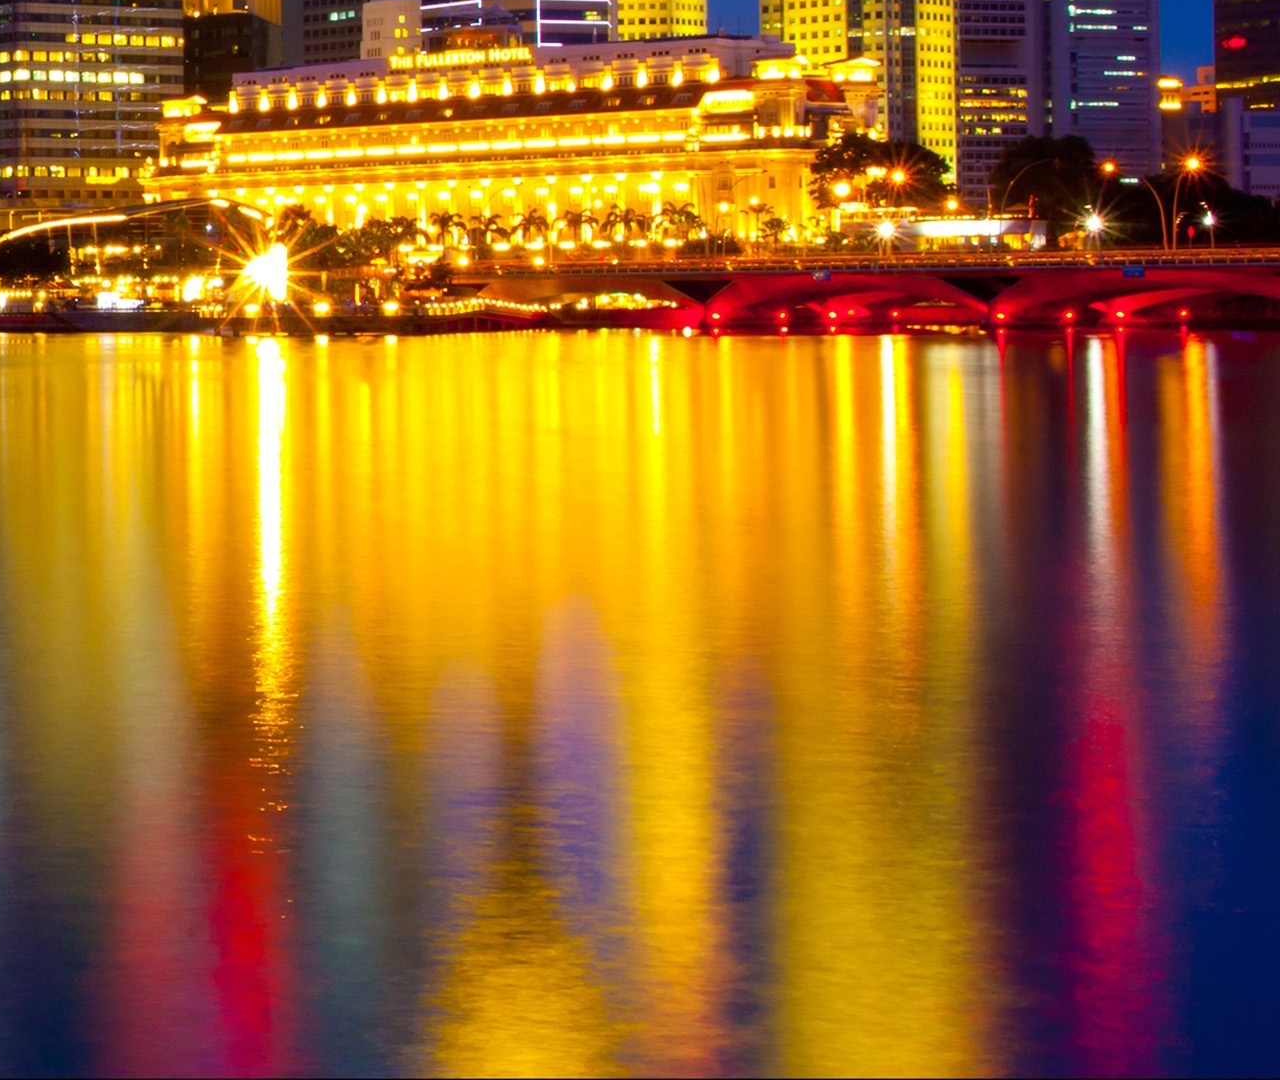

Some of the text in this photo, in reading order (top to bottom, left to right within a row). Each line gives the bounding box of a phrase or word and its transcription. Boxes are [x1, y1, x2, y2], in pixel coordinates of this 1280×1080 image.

[389, 47, 532, 69] THE FULLERTON HOTEL
